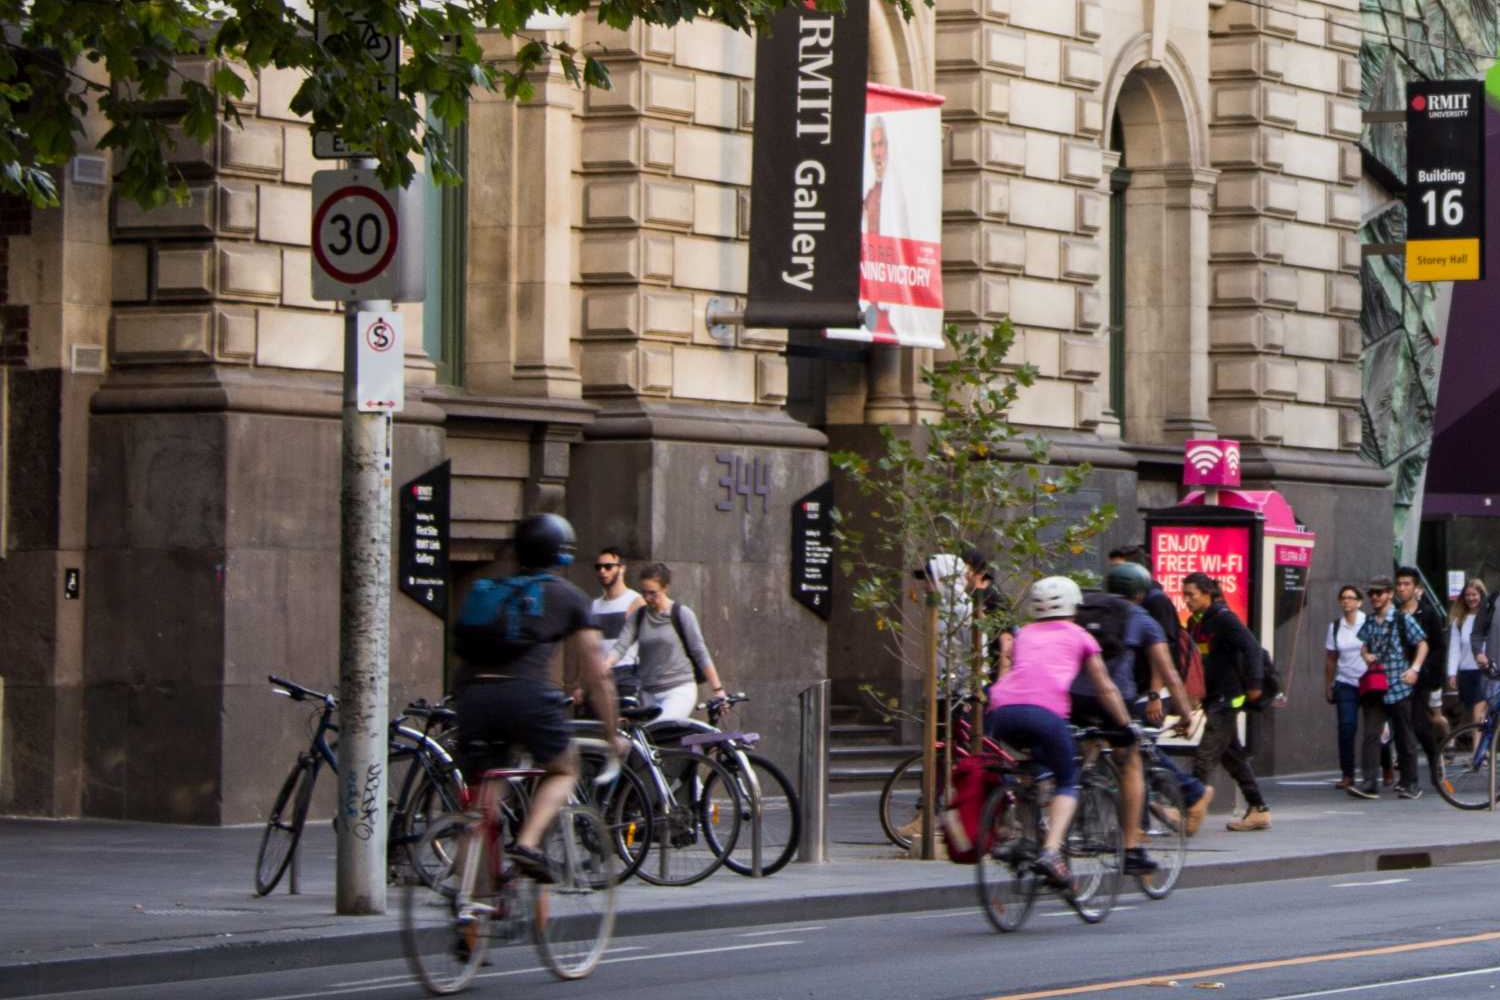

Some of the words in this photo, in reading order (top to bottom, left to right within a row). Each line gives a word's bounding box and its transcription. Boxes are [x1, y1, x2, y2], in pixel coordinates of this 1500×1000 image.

[796, 15, 834, 145] RMIT
[1427, 93, 1471, 110] RMIT
[1429, 110, 1469, 119] UNIVERSITY
[1418, 169, 1466, 184] Building
[1422, 189, 1464, 226] 16
[328, 213, 382, 256] 30
[782, 159, 826, 291] Gallery
[1417, 256, 1447, 267] Storey
[1450, 255, 1468, 264] Hall
[887, 264, 931, 287] VICTORY
[715, 453, 769, 515] 344
[1158, 534, 1210, 552] ENJOY
[1157, 554, 1198, 573] FREE
[1201, 555, 1243, 573] WI-FI
